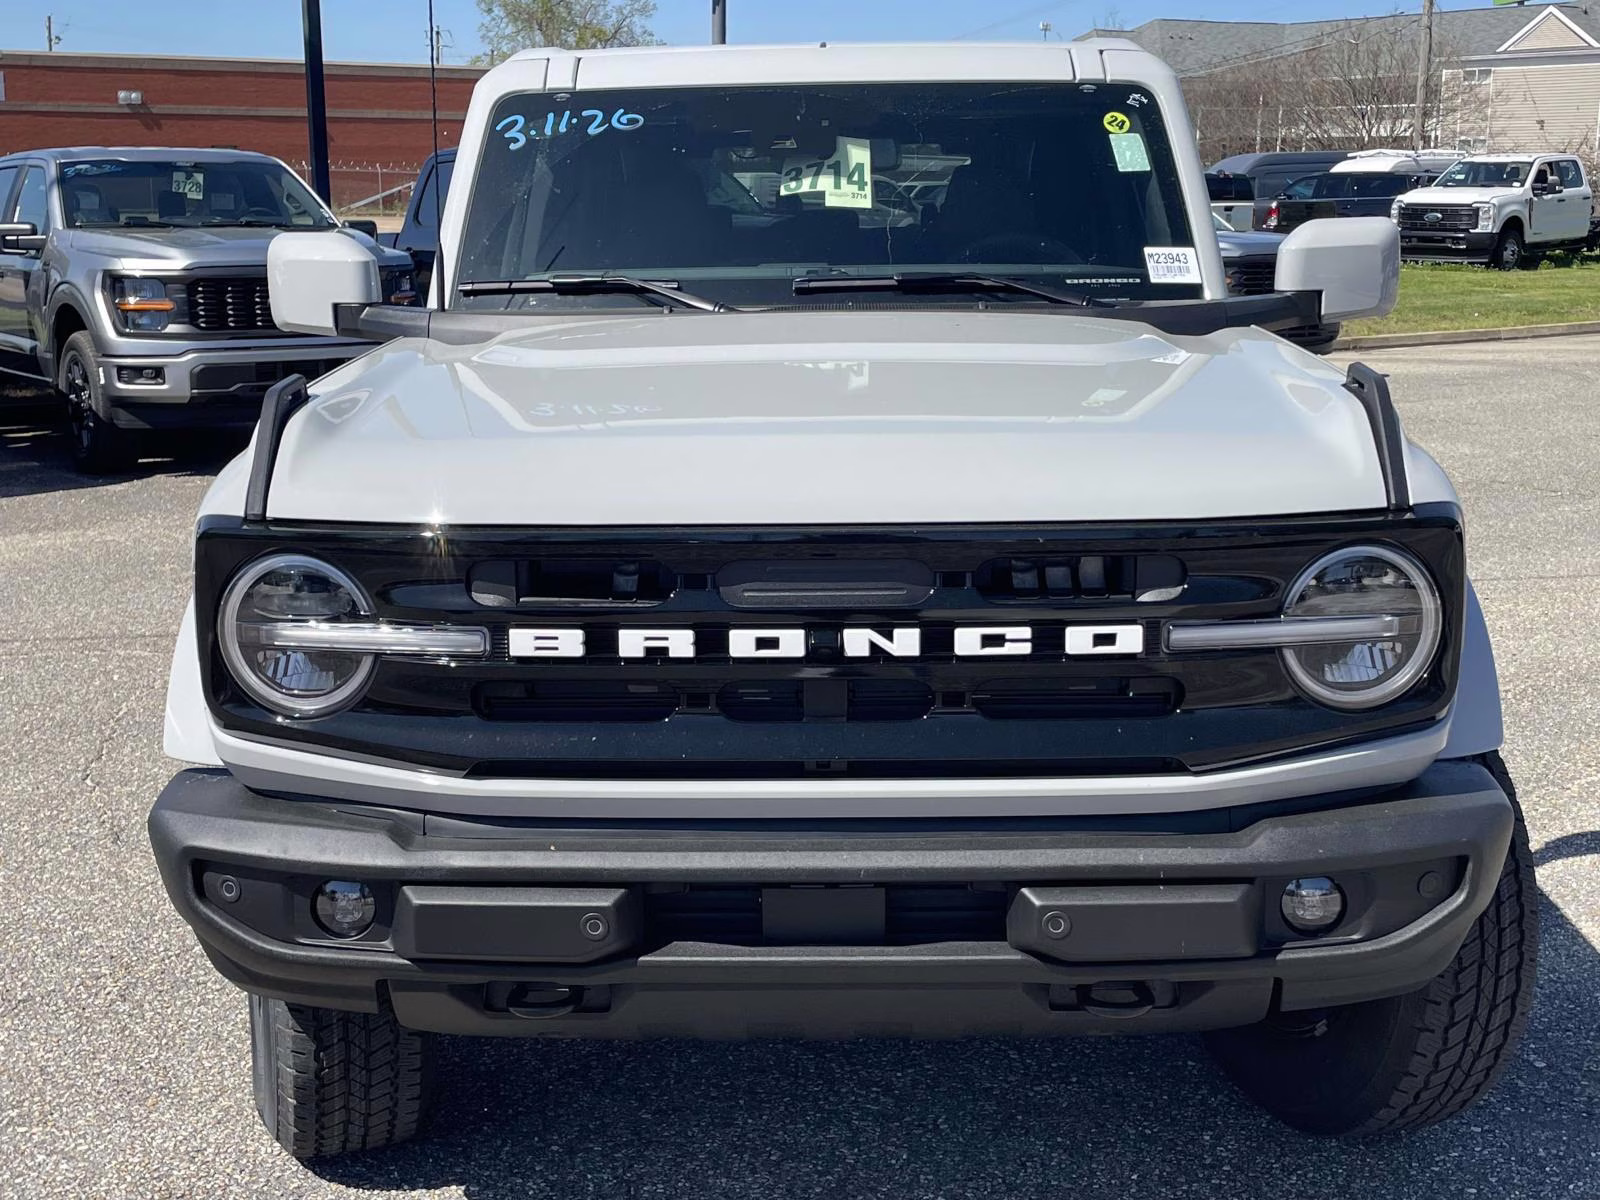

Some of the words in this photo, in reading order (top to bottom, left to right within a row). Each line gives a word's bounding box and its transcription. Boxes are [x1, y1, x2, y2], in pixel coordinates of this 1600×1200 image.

[1106, 114, 1127, 131] 24
[783, 160, 868, 193] 3714
[173, 180, 202, 193] 3728
[850, 192, 868, 200] 3714
[1147, 252, 1189, 265] M23943
[508, 624, 1144, 657] BRONCO
